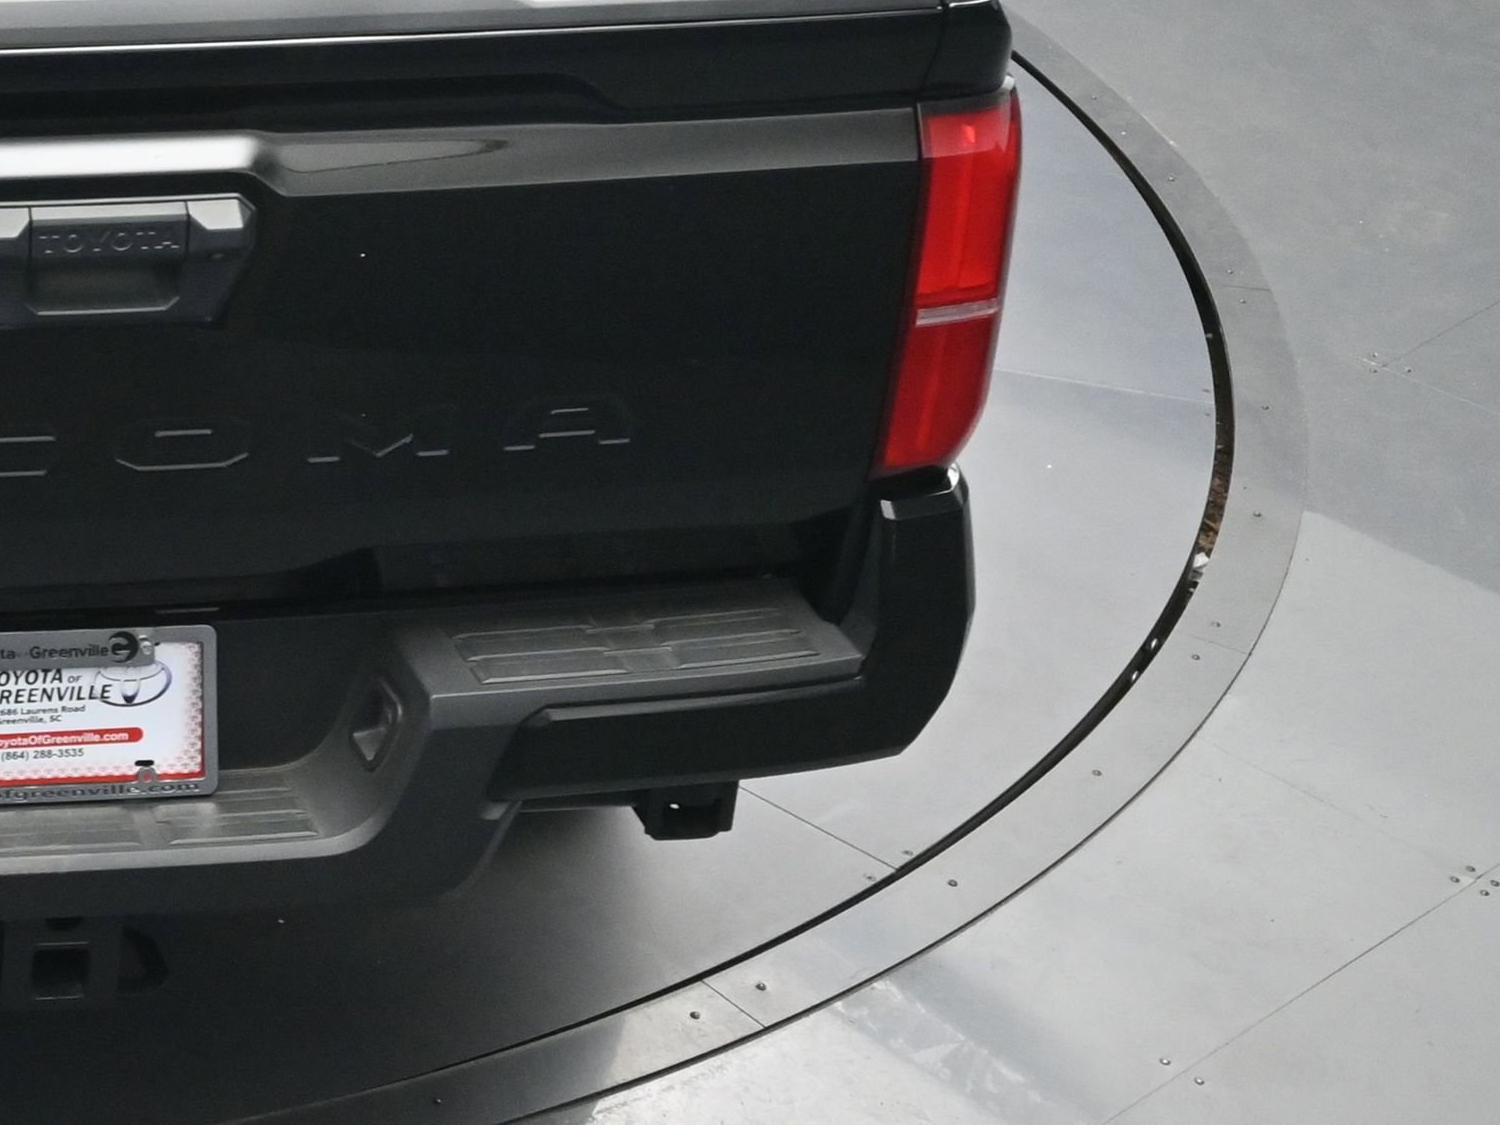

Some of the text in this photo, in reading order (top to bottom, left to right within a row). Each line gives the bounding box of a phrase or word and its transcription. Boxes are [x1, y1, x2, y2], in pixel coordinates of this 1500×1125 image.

[36, 229, 181, 254] TOYOTA
[29, 643, 108, 660] Greenville
[20, 706, 59, 716] Laurens
[60, 704, 87, 714] Road
[49, 714, 63, 723] SC
[1, 750, 29, 762] (864)
